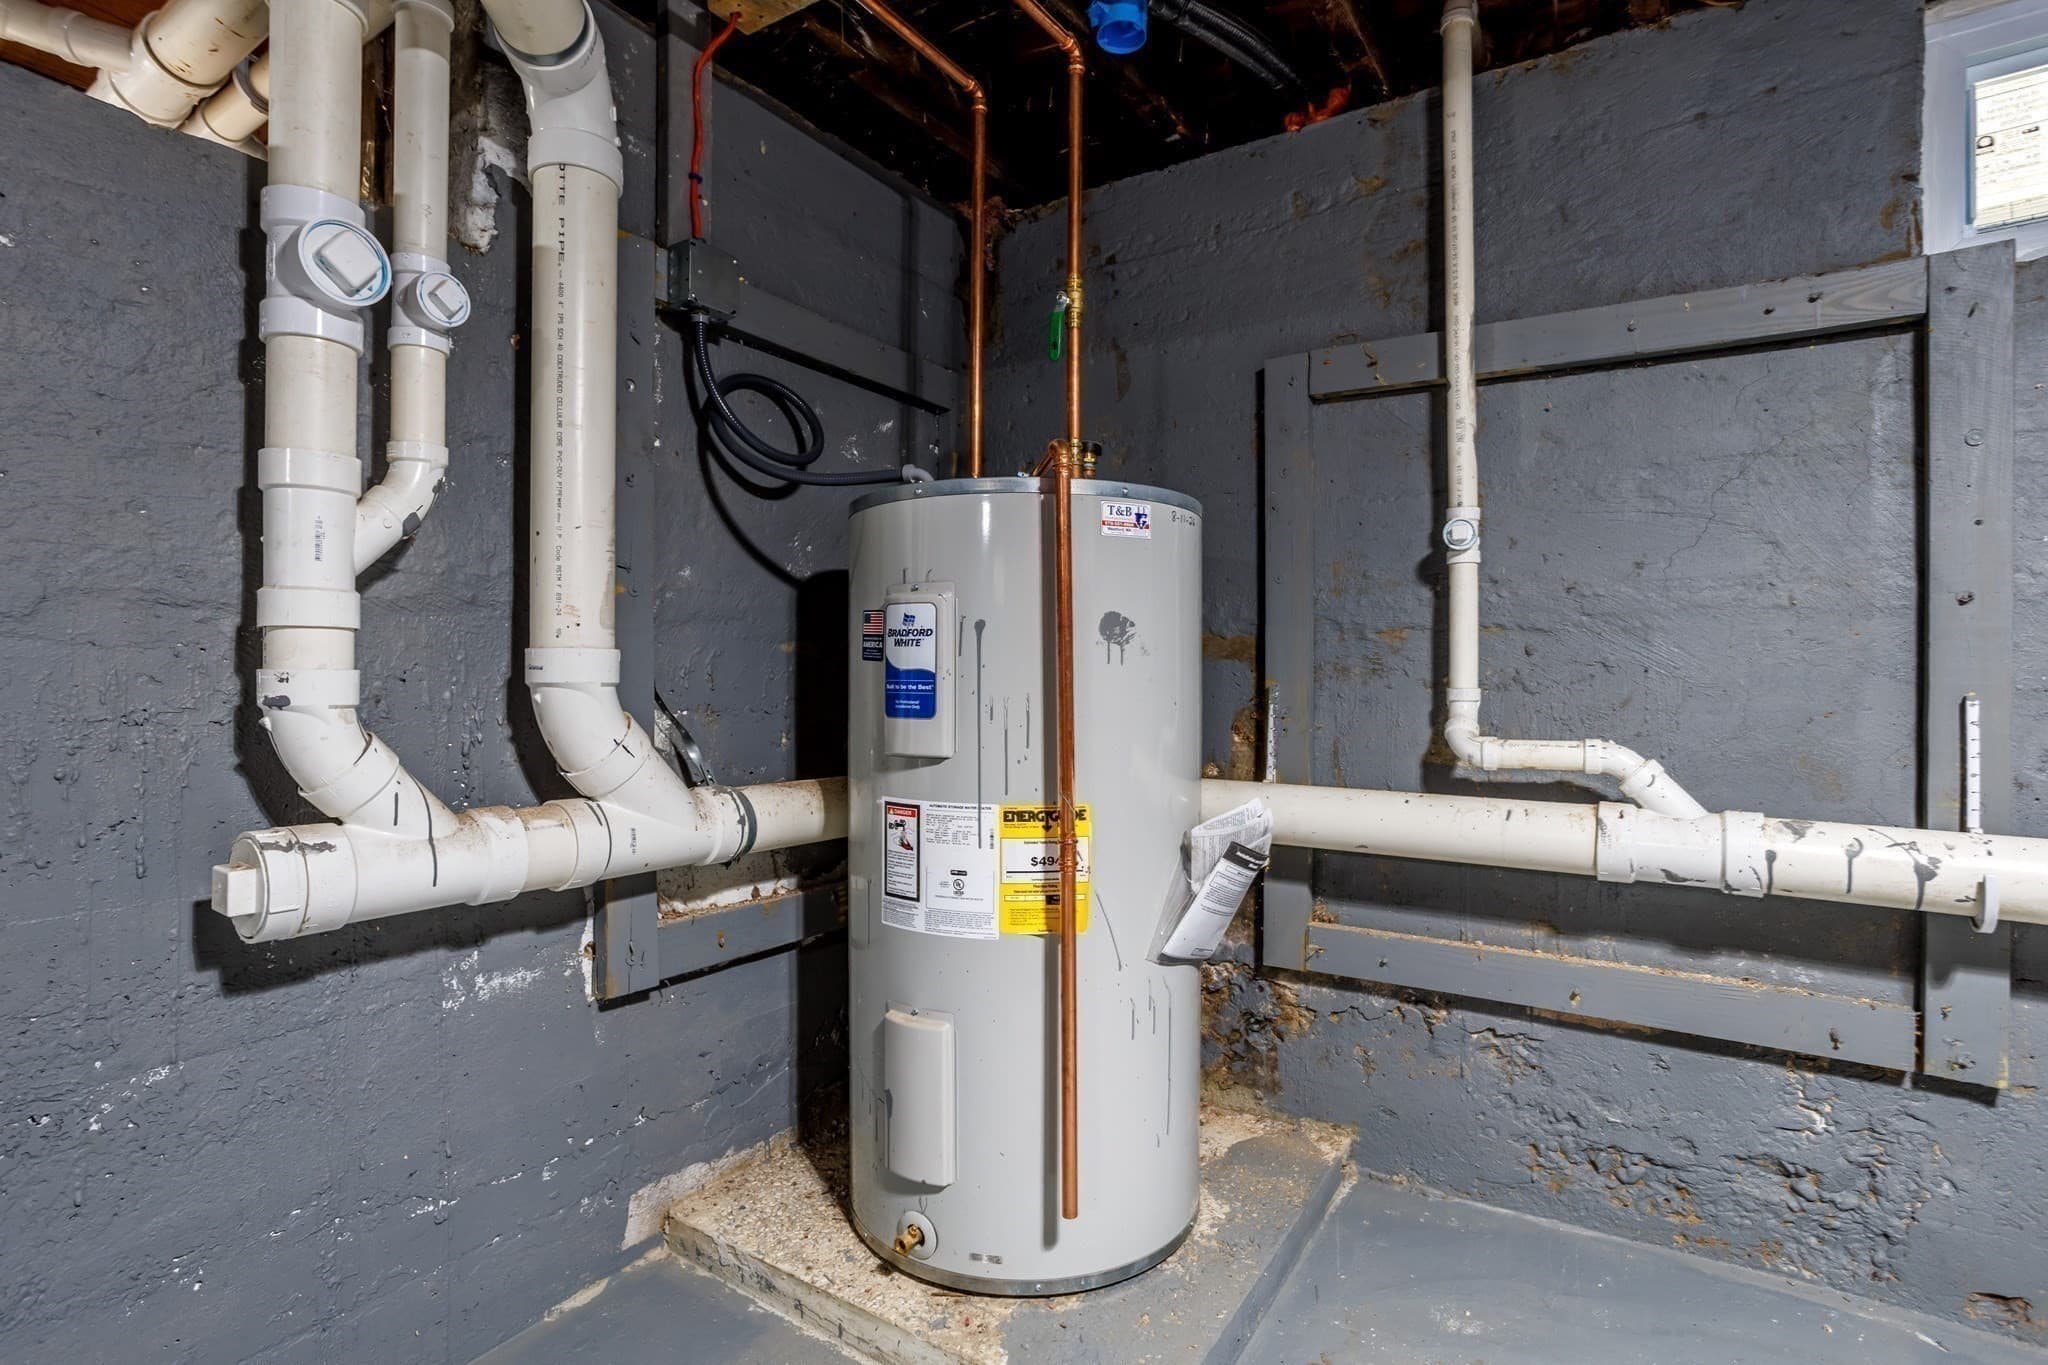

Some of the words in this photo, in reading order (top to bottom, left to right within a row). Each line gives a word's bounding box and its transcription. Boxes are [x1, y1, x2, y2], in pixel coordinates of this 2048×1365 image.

[1107, 505, 1132, 516] T&B
[888, 628, 933, 637] BRADFORD
[894, 639, 921, 647] WHITE
